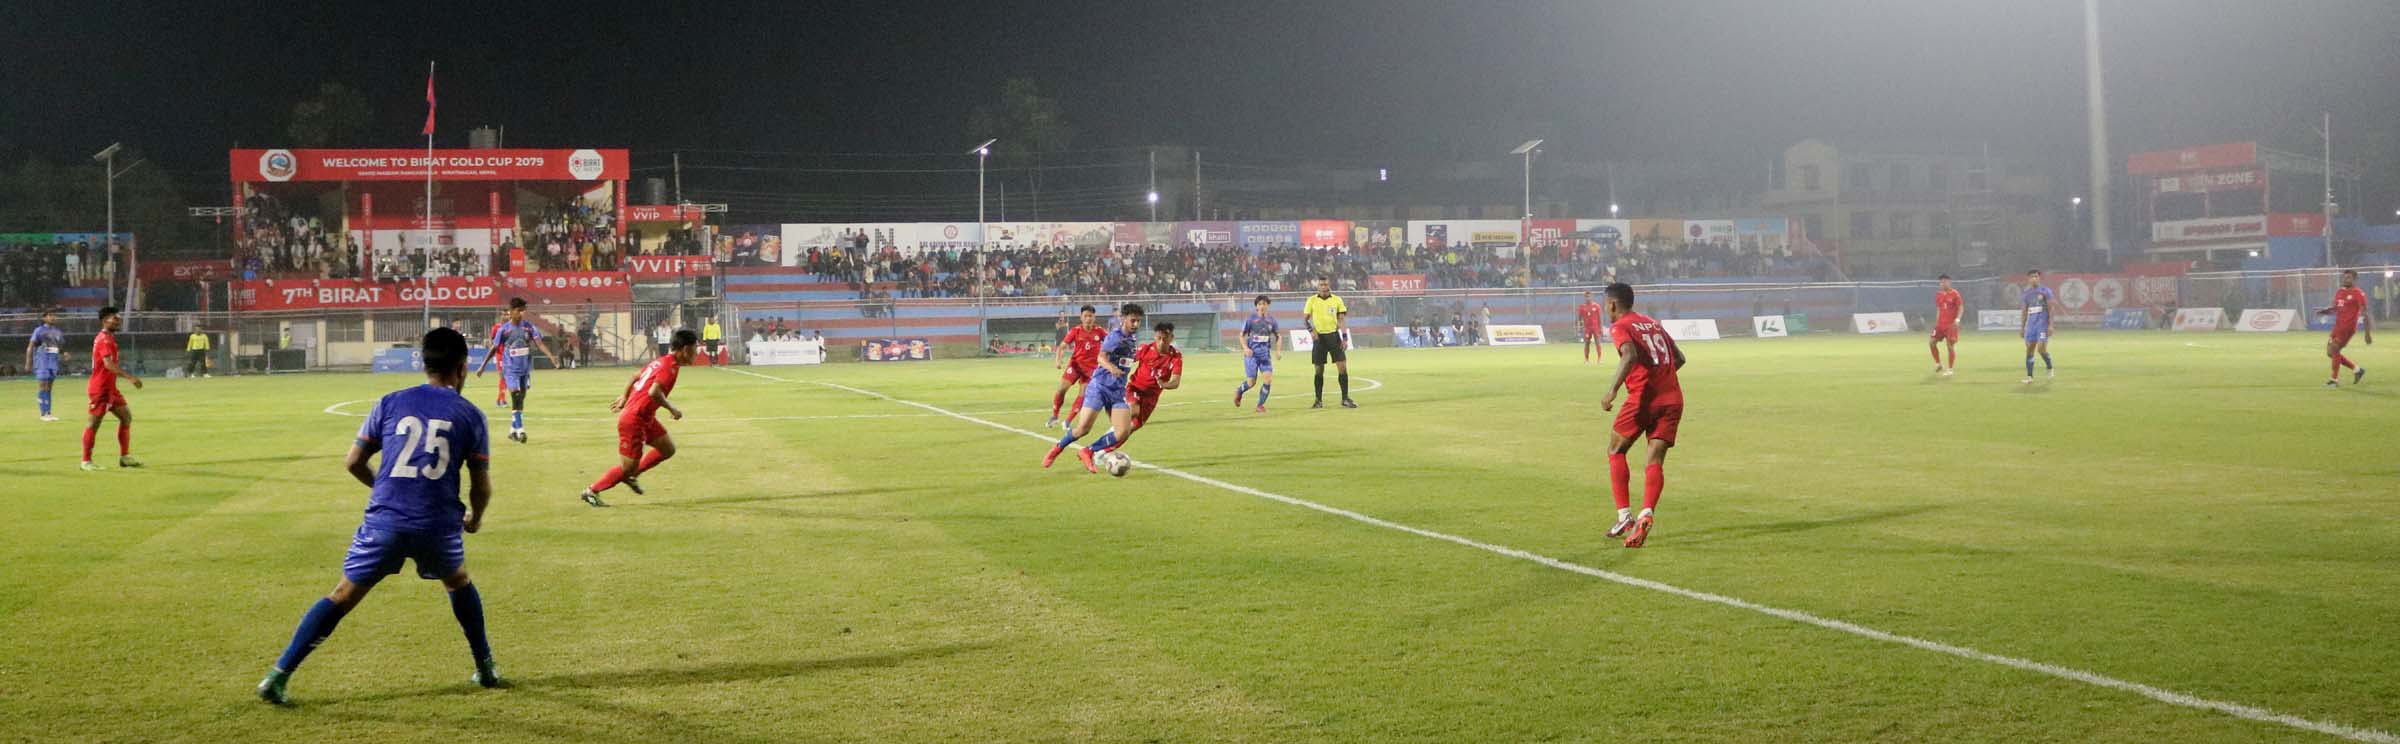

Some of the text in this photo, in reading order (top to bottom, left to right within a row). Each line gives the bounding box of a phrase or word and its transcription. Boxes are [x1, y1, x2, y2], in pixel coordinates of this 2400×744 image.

[322, 156, 545, 168] WELCOME TO BIRAT GOLD CUP 2079
[632, 211, 661, 220] VVIP
[631, 259, 687, 273] VVIP
[1392, 279, 1422, 290] EXIT
[319, 287, 383, 304] BIRAT
[400, 287, 451, 301] GOLD
[455, 287, 493, 300] CUP
[1084, 341, 1092, 351] 6
[1641, 333, 1670, 365] 19
[389, 415, 453, 480] 25
